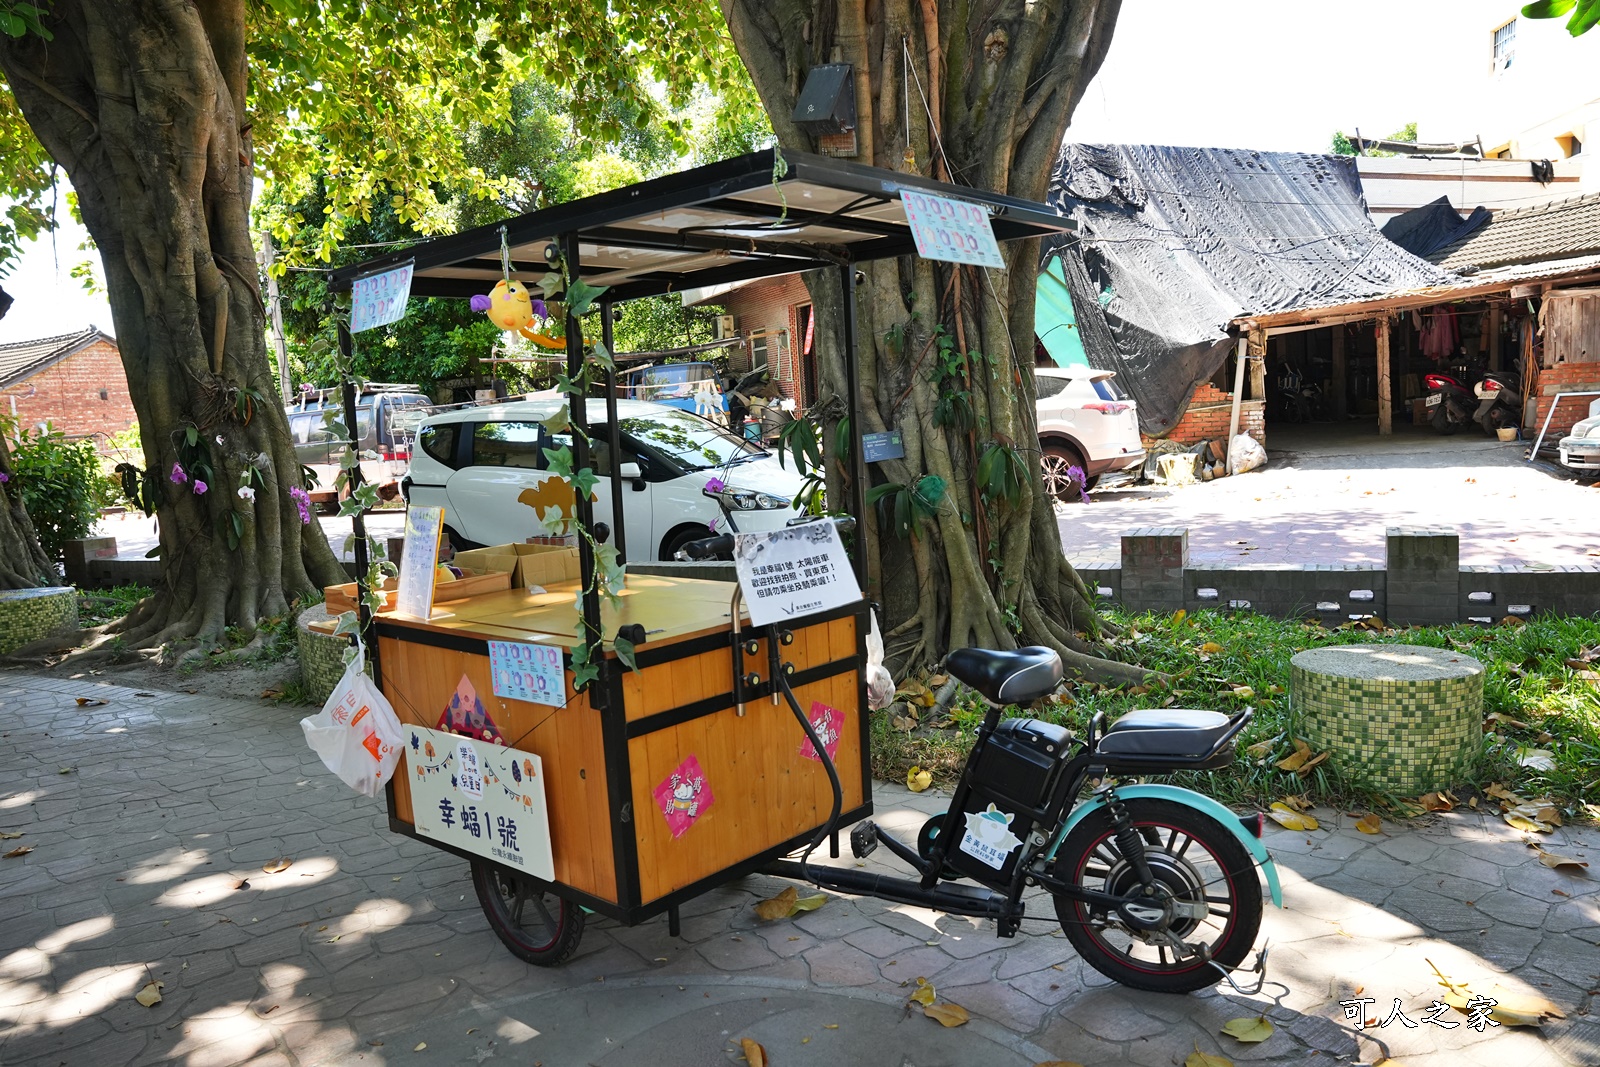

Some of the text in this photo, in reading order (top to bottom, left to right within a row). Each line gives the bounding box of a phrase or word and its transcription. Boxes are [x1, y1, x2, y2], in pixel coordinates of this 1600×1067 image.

[797, 553, 829, 568] 太陽能車
[439, 797, 520, 852] 幸蝠1號
